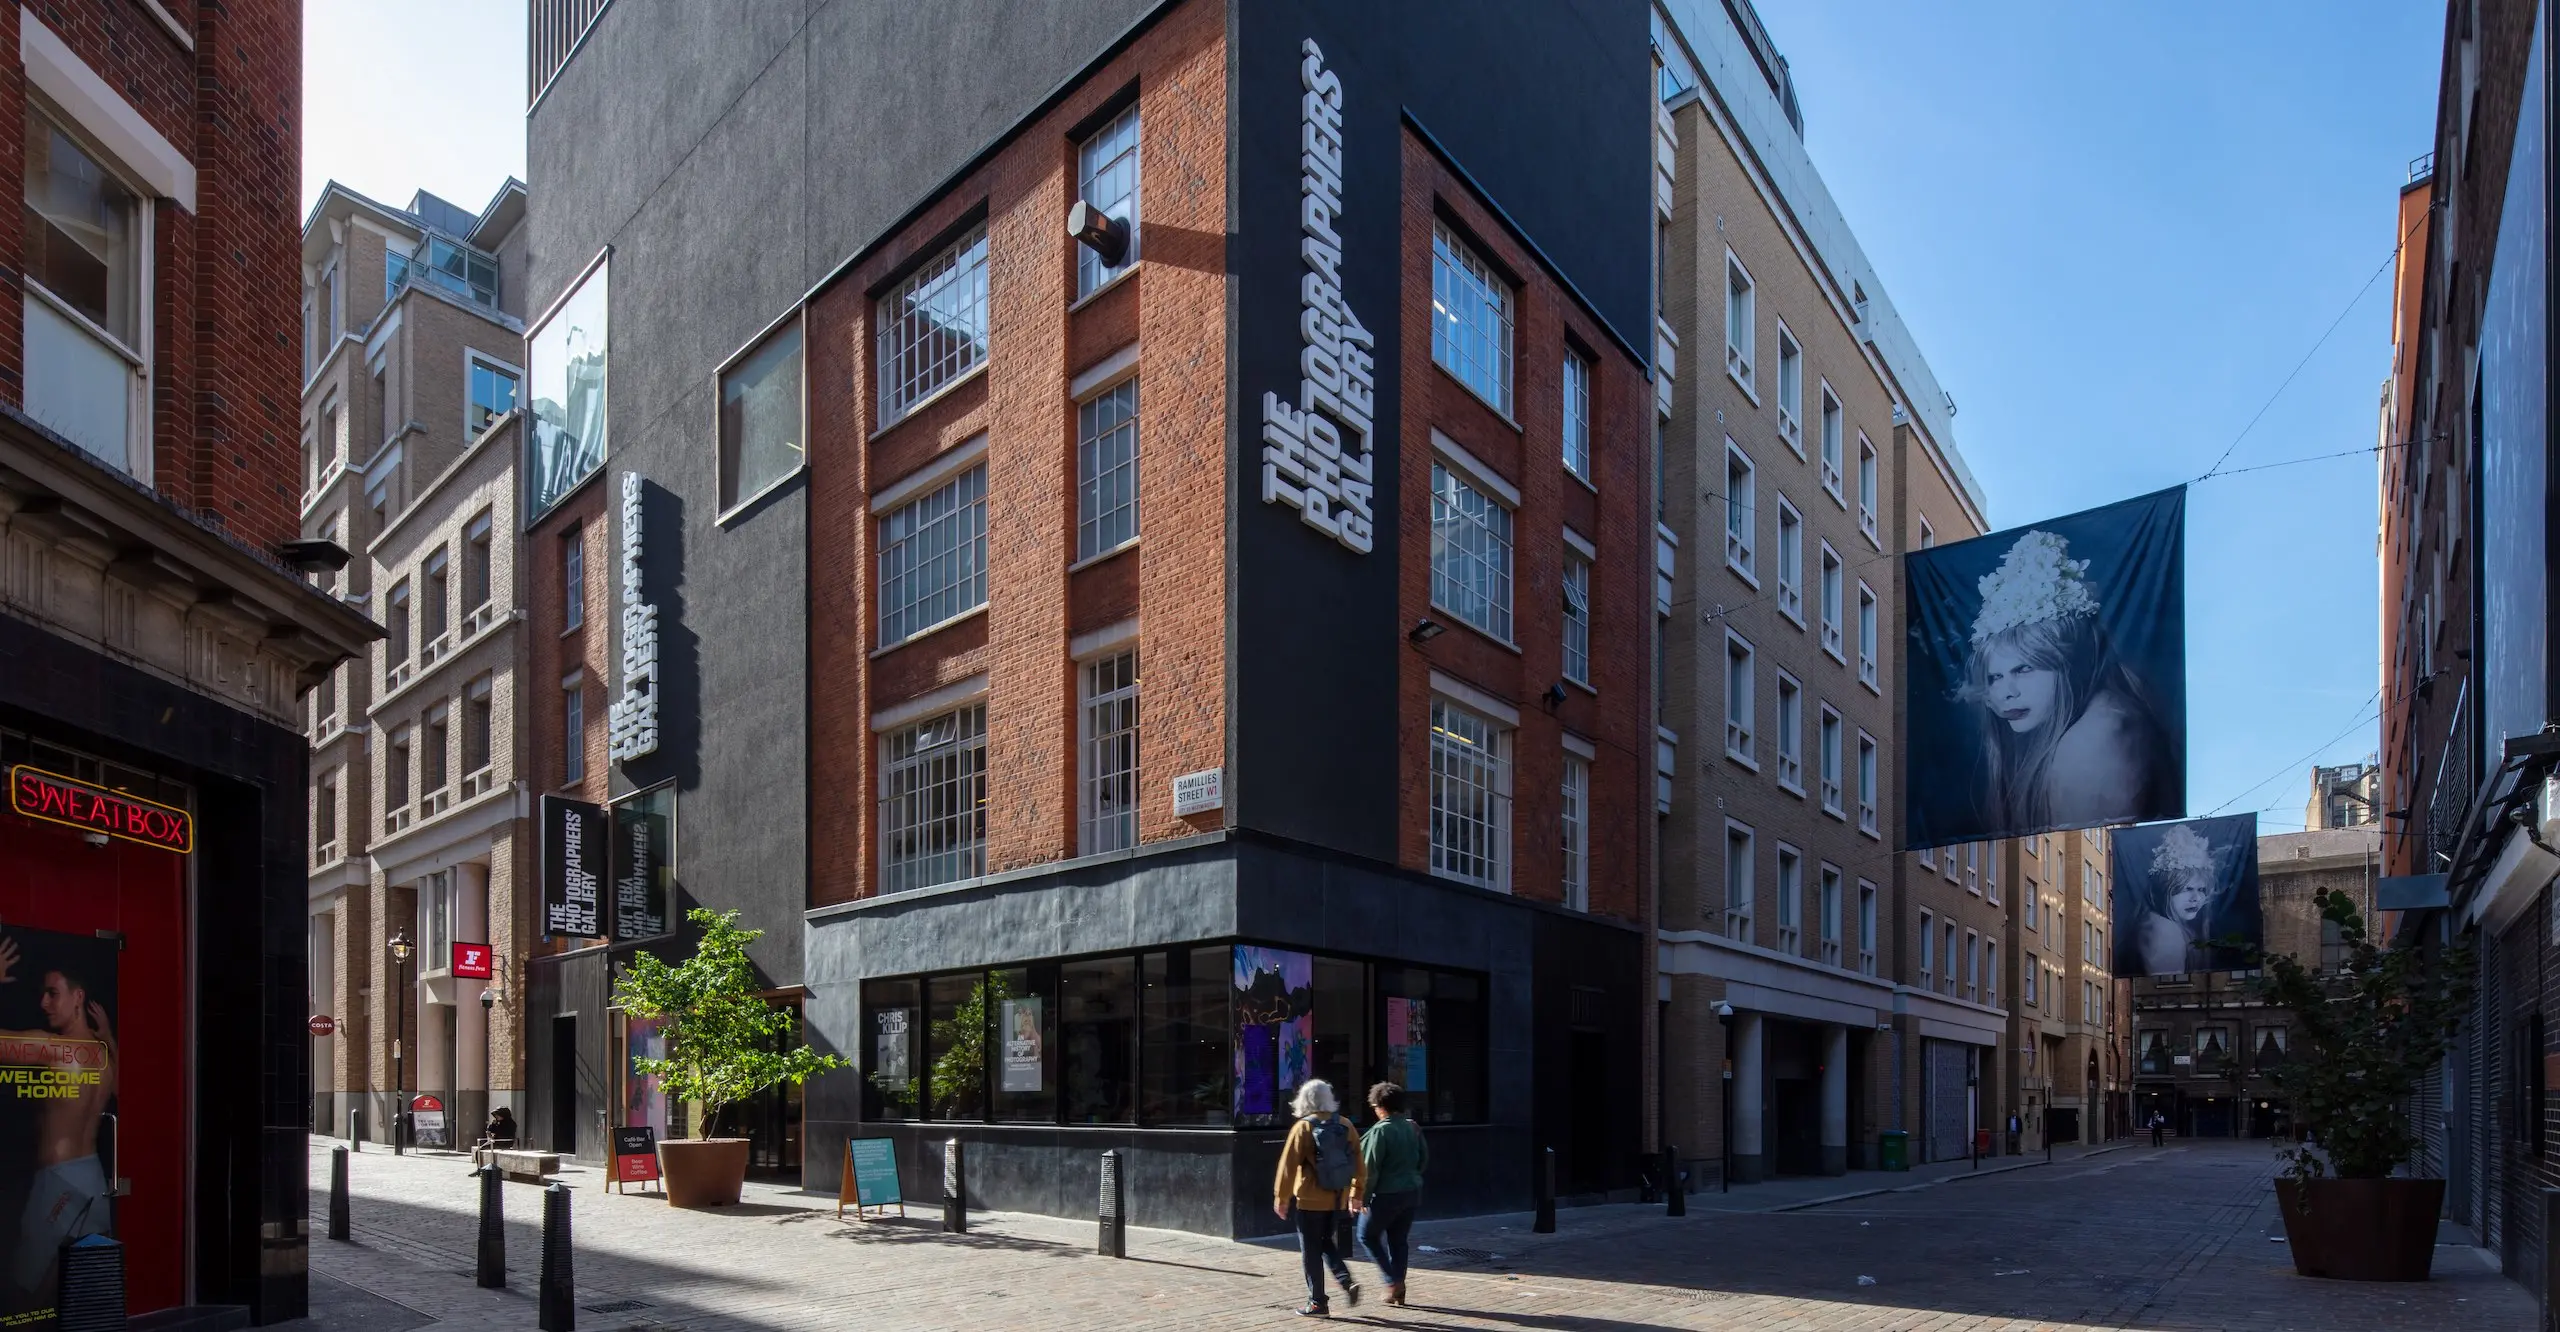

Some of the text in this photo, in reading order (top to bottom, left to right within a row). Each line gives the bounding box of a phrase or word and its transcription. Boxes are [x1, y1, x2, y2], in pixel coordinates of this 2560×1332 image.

[1335, 299, 1375, 555] GALLERY
[1262, 390, 1306, 509] THE
[637, 603, 658, 755] GALLERY
[609, 699, 625, 766] THE
[1178, 773, 1217, 791] RAMILLIES
[1178, 785, 1217, 803] STREET W1
[20, 775, 184, 845] SWEATBOX
[565, 808, 582, 933] PHOTOGRAPHERS'
[581, 871, 597, 934] GALLERY
[550, 903, 566, 931] THE
[877, 1011, 903, 1024] CHRIS
[882, 1021, 908, 1034] KILLIP
[0, 1041, 101, 1065] WEATBOX
[0, 1069, 101, 1085] WELCOME
[16, 1085, 80, 1099] HOME
